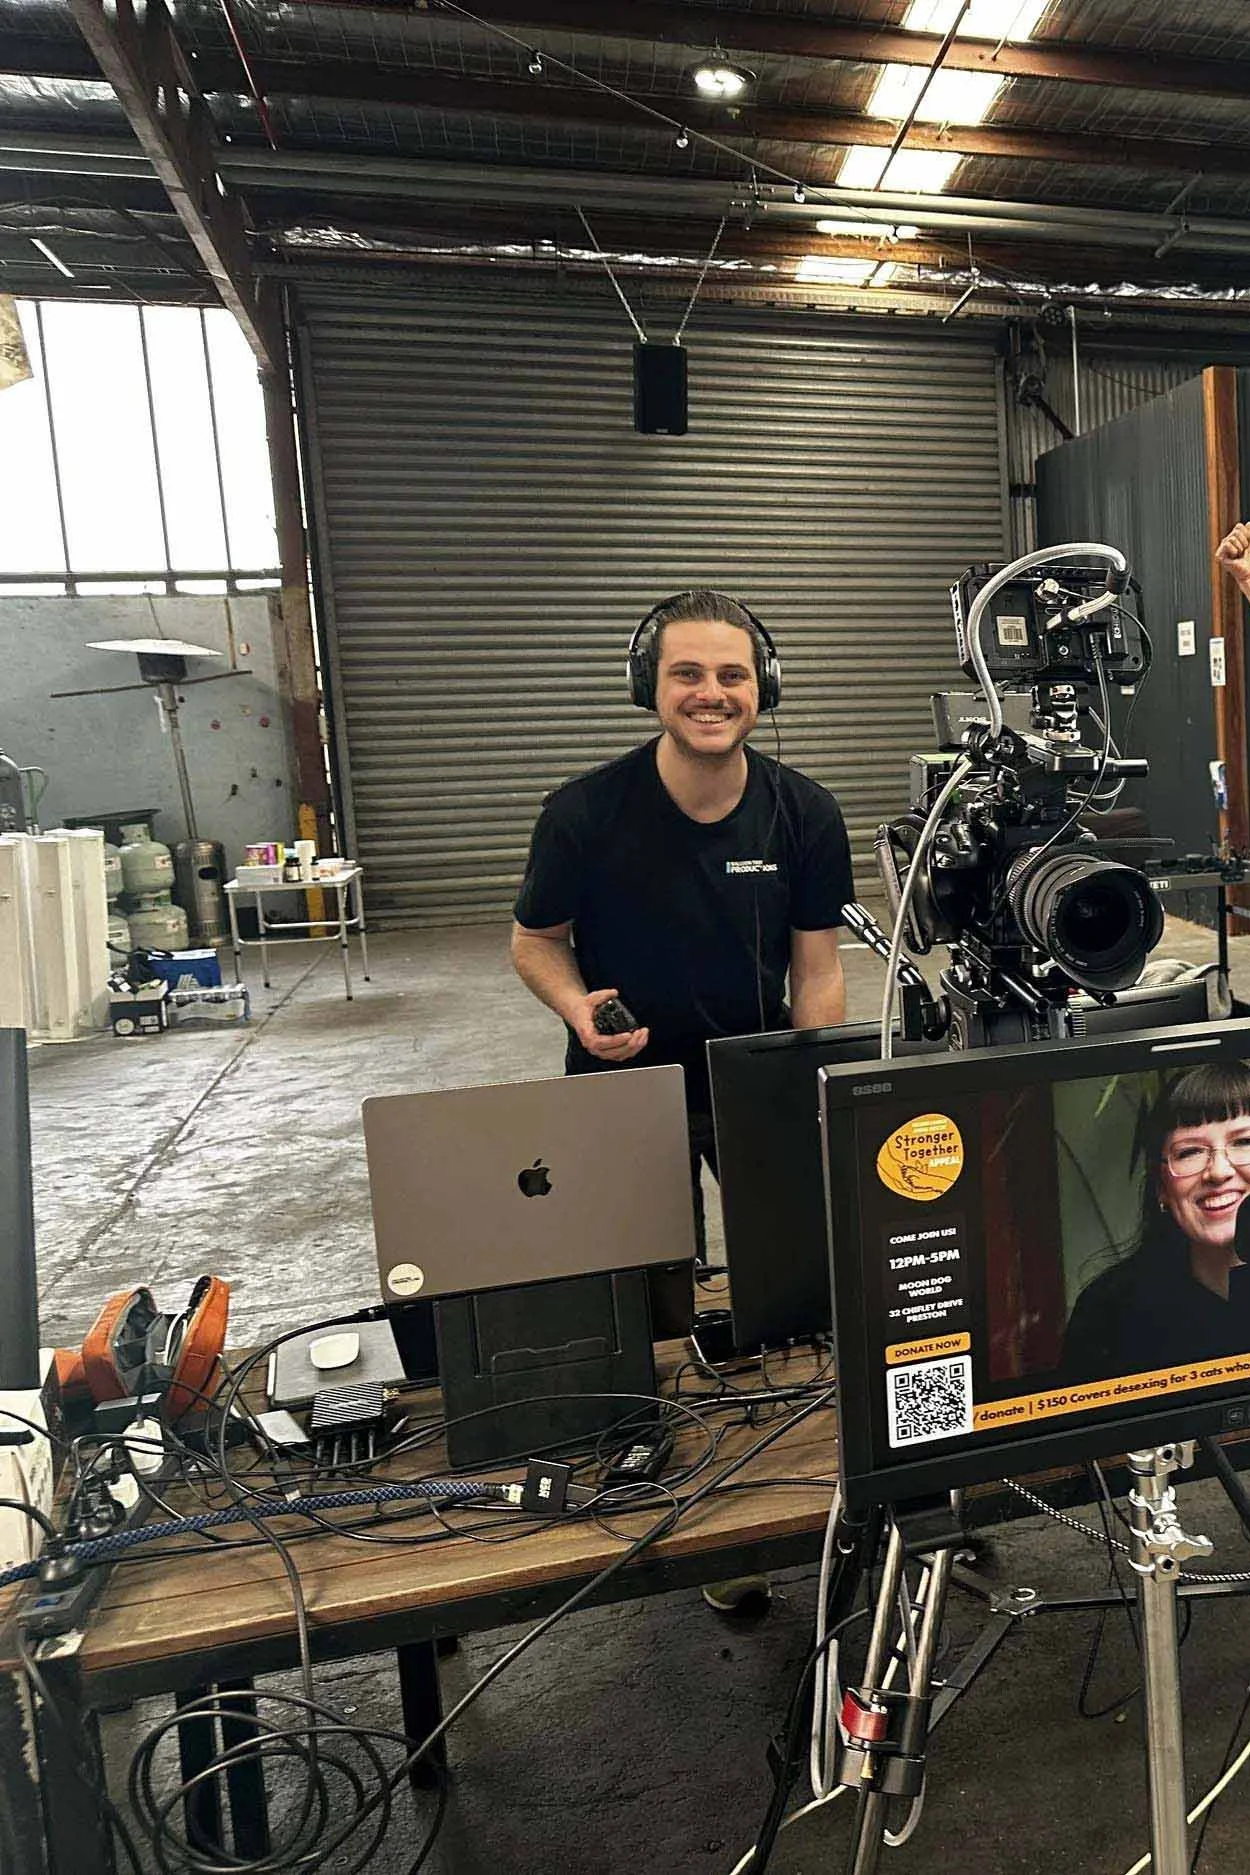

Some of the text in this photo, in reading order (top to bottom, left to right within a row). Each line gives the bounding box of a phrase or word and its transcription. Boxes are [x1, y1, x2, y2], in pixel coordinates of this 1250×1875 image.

[1150, 880, 1169, 889] ETI
[895, 1132, 954, 1149] Stronger
[903, 1144, 959, 1160] Together
[889, 1233, 917, 1244] COME
[916, 1230, 940, 1241] JOIN
[889, 1249, 960, 1270] 12PM-5PM
[898, 1275, 953, 1291] MOON DOG
[908, 1286, 943, 1298] WORLD
[888, 1298, 964, 1318] 32 CHIFLEY DRIVE
[906, 1309, 948, 1324] PRESTON
[895, 1339, 961, 1357] DONATE NOW
[1037, 1395, 1067, 1410] $150
[1070, 1388, 1112, 1404] Covers
[1113, 1378, 1168, 1396] desexing
[1169, 1373, 1188, 1384] for
[1189, 1370, 1198, 1380] 3
[1200, 1366, 1224, 1379] cats
